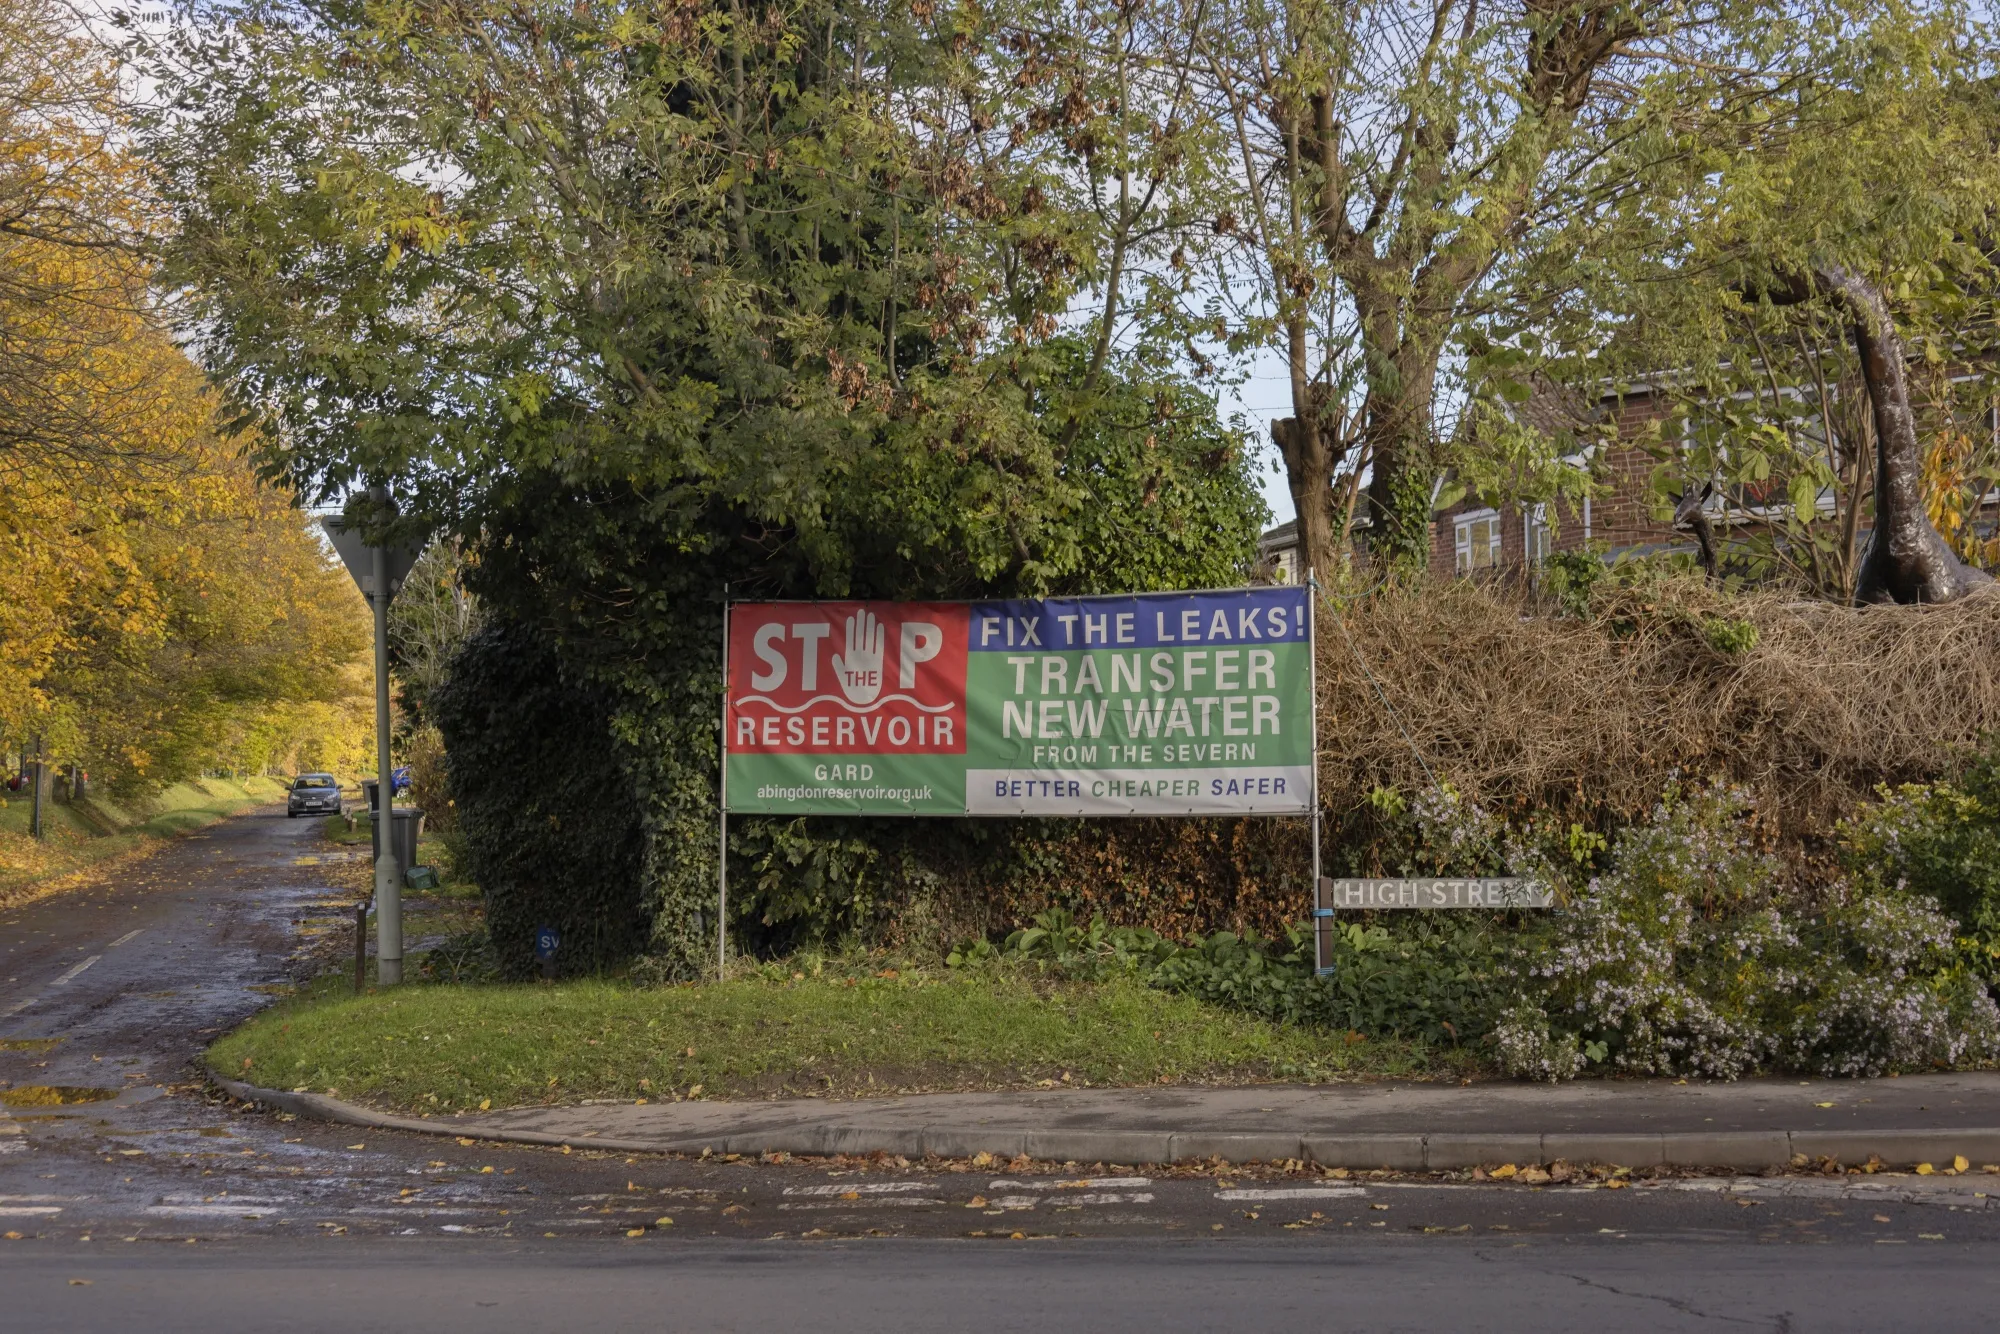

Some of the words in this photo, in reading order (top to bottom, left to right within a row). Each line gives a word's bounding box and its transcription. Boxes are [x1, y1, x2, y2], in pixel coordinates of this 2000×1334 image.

[981, 616, 1042, 647] FIX
[1058, 612, 1136, 645] THE
[1156, 605, 1304, 643] LEAKS!
[844, 670, 878, 687] THE
[1007, 649, 1276, 695] TRANSFER
[1002, 699, 1108, 739] NEW
[1122, 695, 1281, 739] WATER
[736, 716, 954, 746] RESERVOIR
[1033, 745, 1098, 763] FROM
[1108, 745, 1152, 763] THE
[1163, 743, 1256, 762] SEVERN
[814, 764, 874, 781] GARD
[757, 785, 932, 801] abingdonreservoir.org.uk
[995, 780, 1081, 797] BETTER
[1092, 779, 1200, 797] CHEAPER
[1211, 777, 1286, 796] SAFER
[1344, 882, 1418, 905] HIGH
